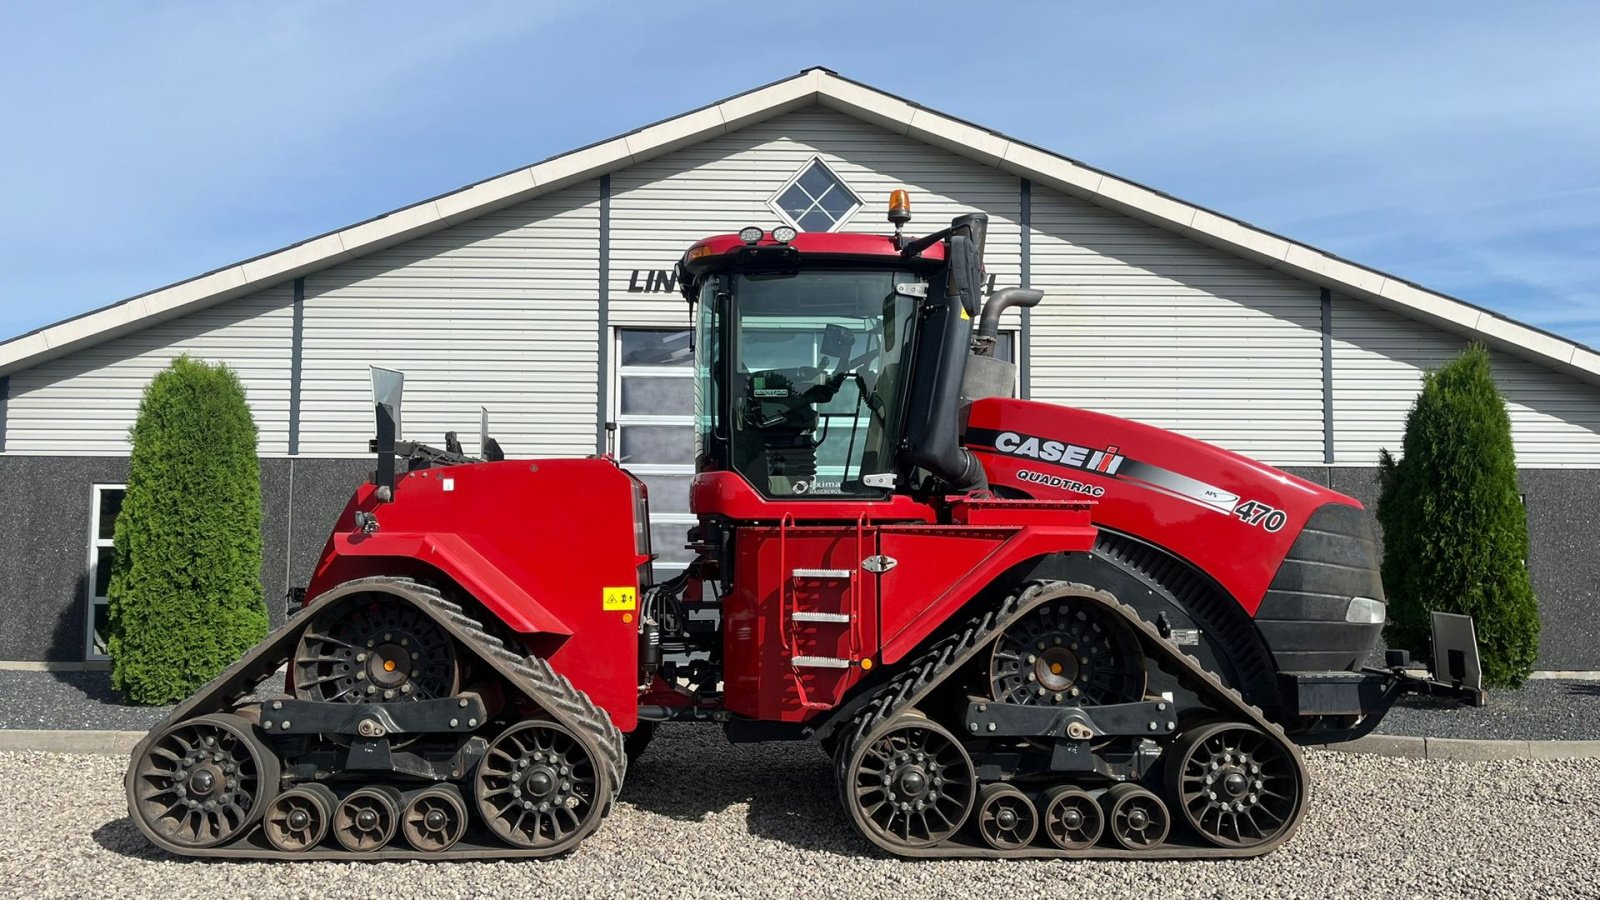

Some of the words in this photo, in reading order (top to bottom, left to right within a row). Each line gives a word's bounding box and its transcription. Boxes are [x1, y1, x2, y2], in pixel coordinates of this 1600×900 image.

[995, 432, 1090, 467] CASE
[1017, 470, 1105, 497] QUADTRAC
[1234, 500, 1287, 532] 470
